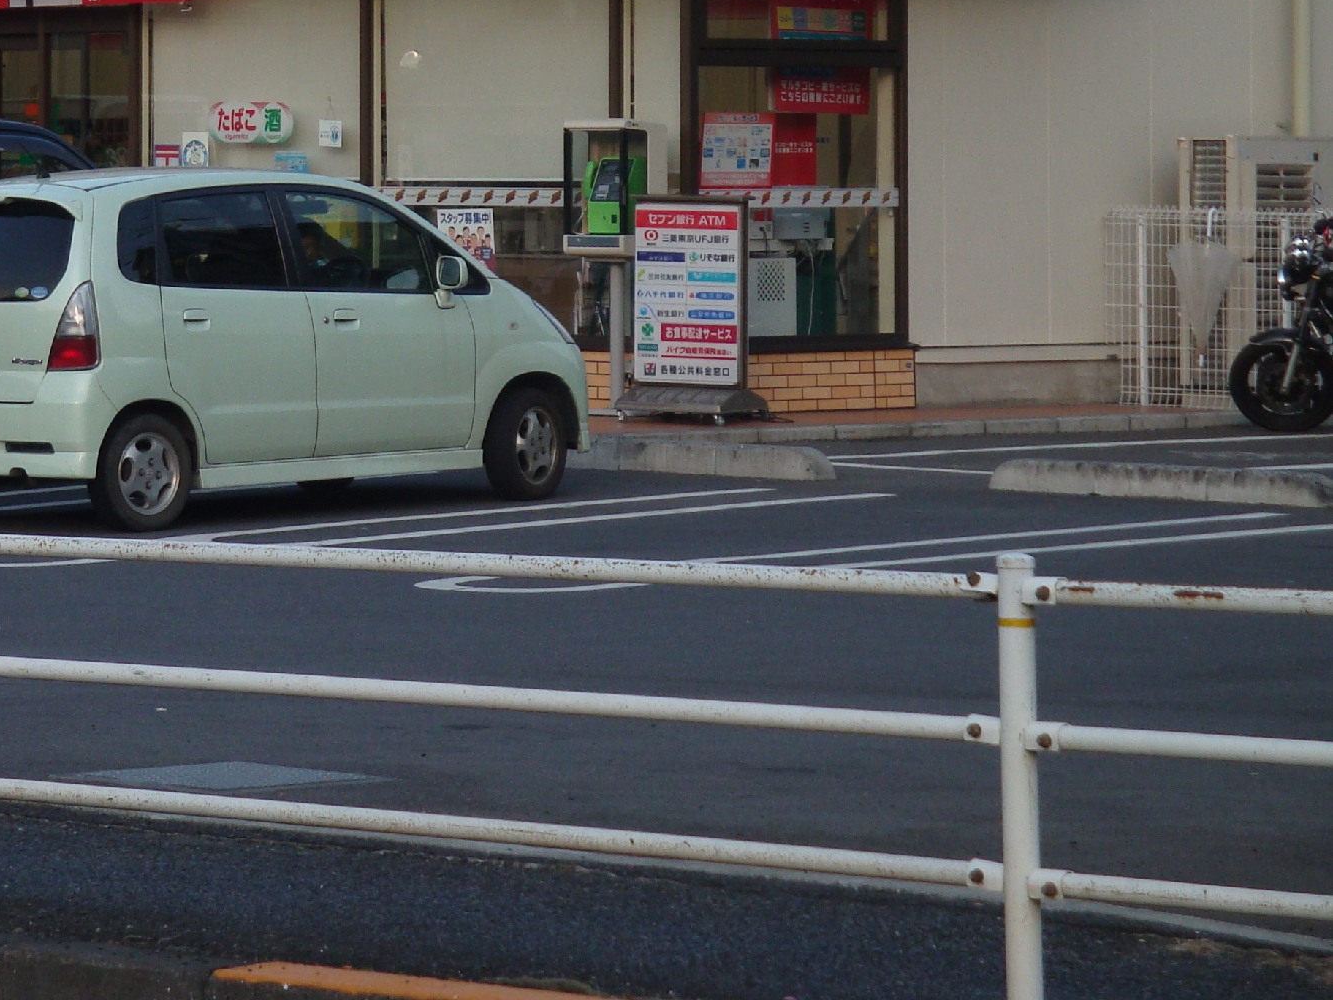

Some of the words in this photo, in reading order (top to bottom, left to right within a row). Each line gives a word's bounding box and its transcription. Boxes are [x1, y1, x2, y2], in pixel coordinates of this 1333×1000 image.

[218, 108, 256, 132] たばこ
[264, 109, 281, 132] 酒
[648, 213, 694, 225] セブン銀行
[699, 215, 726, 226] ATM
[699, 253, 735, 263] りそな銀行
[660, 365, 730, 377] 各種公共料金窓口
